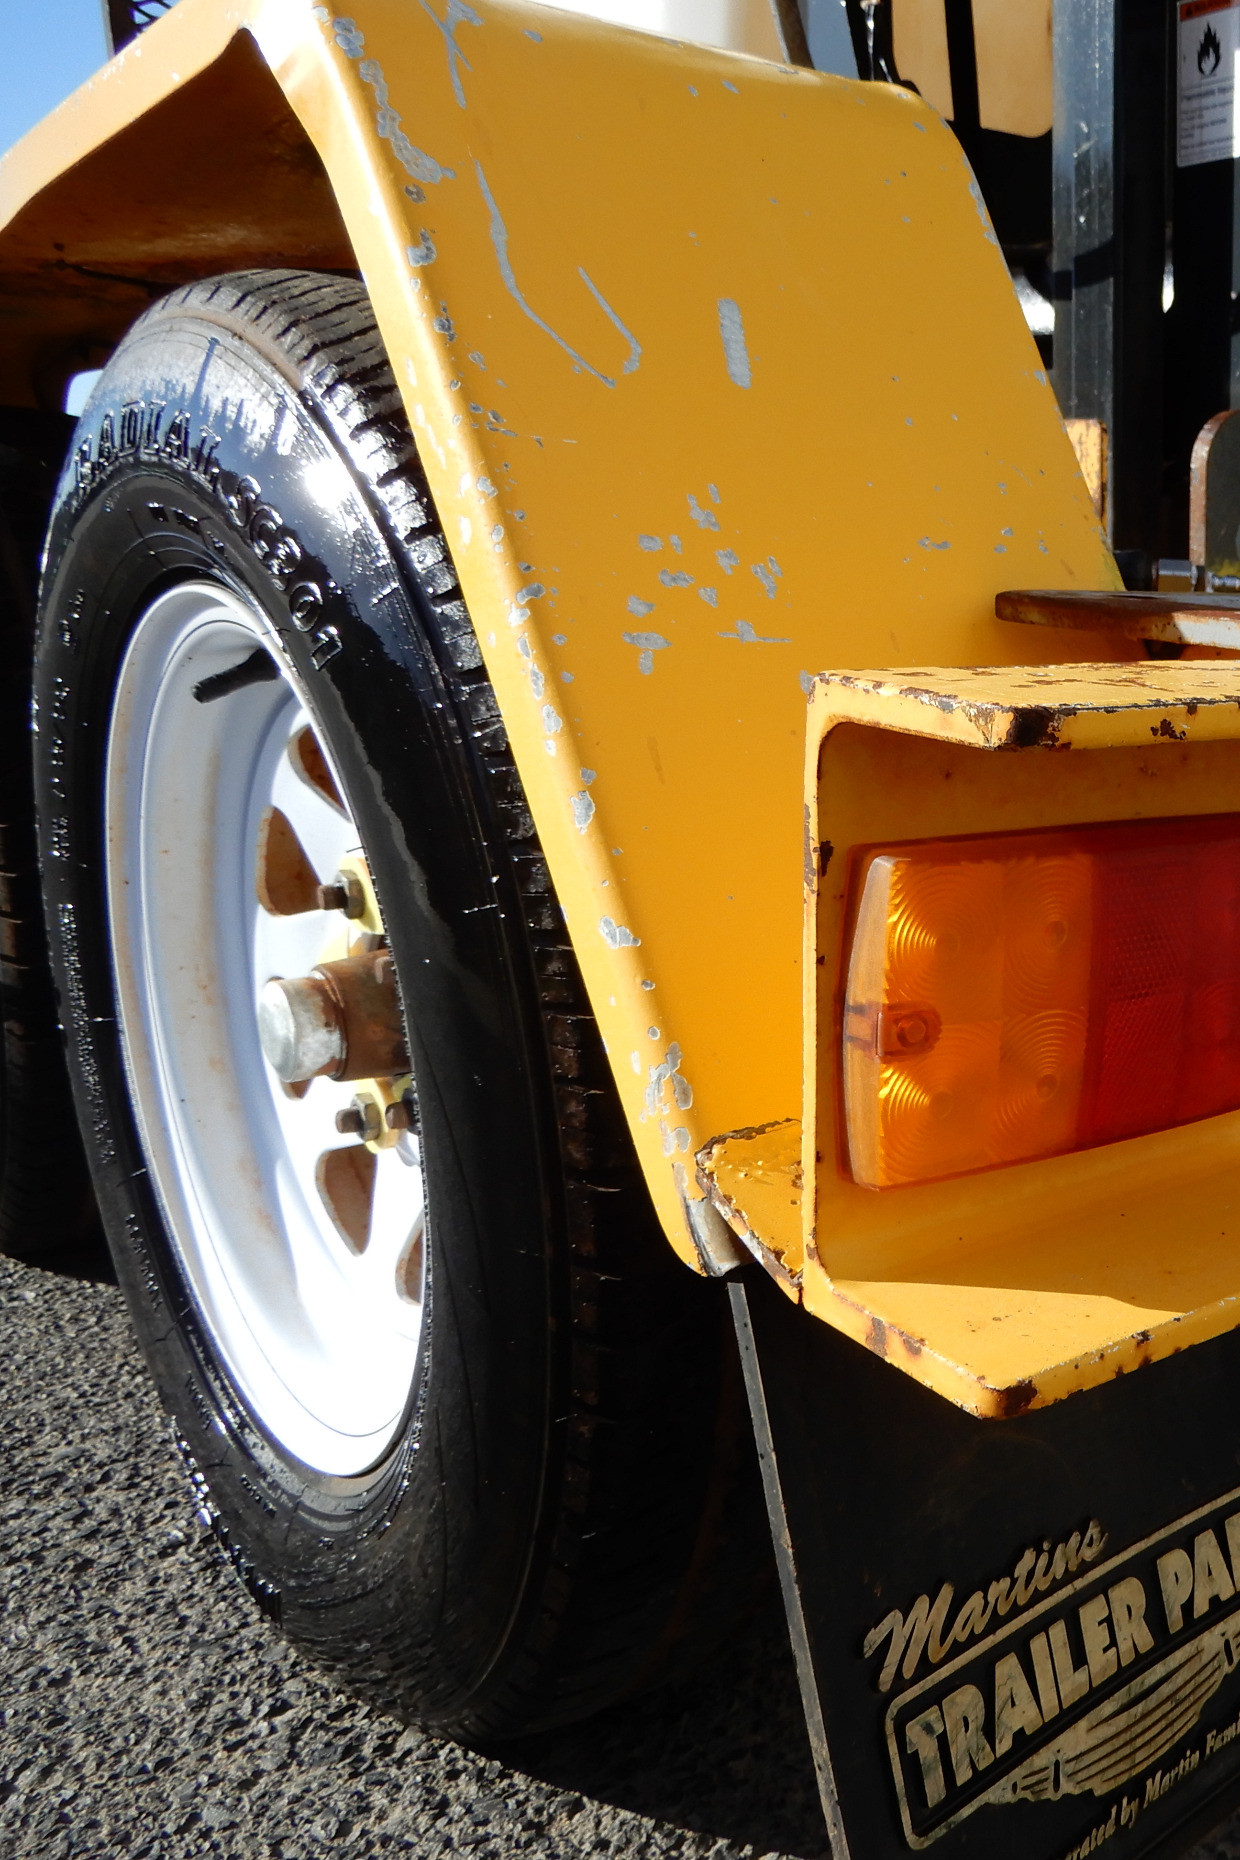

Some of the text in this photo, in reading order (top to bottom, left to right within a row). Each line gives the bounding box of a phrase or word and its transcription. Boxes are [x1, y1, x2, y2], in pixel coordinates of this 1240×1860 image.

[862, 1519, 1108, 1692] Martins
[906, 1577, 1153, 1808] TRAILER
[1120, 1796, 1139, 1829] by
[1143, 1750, 1200, 1809] Martin
